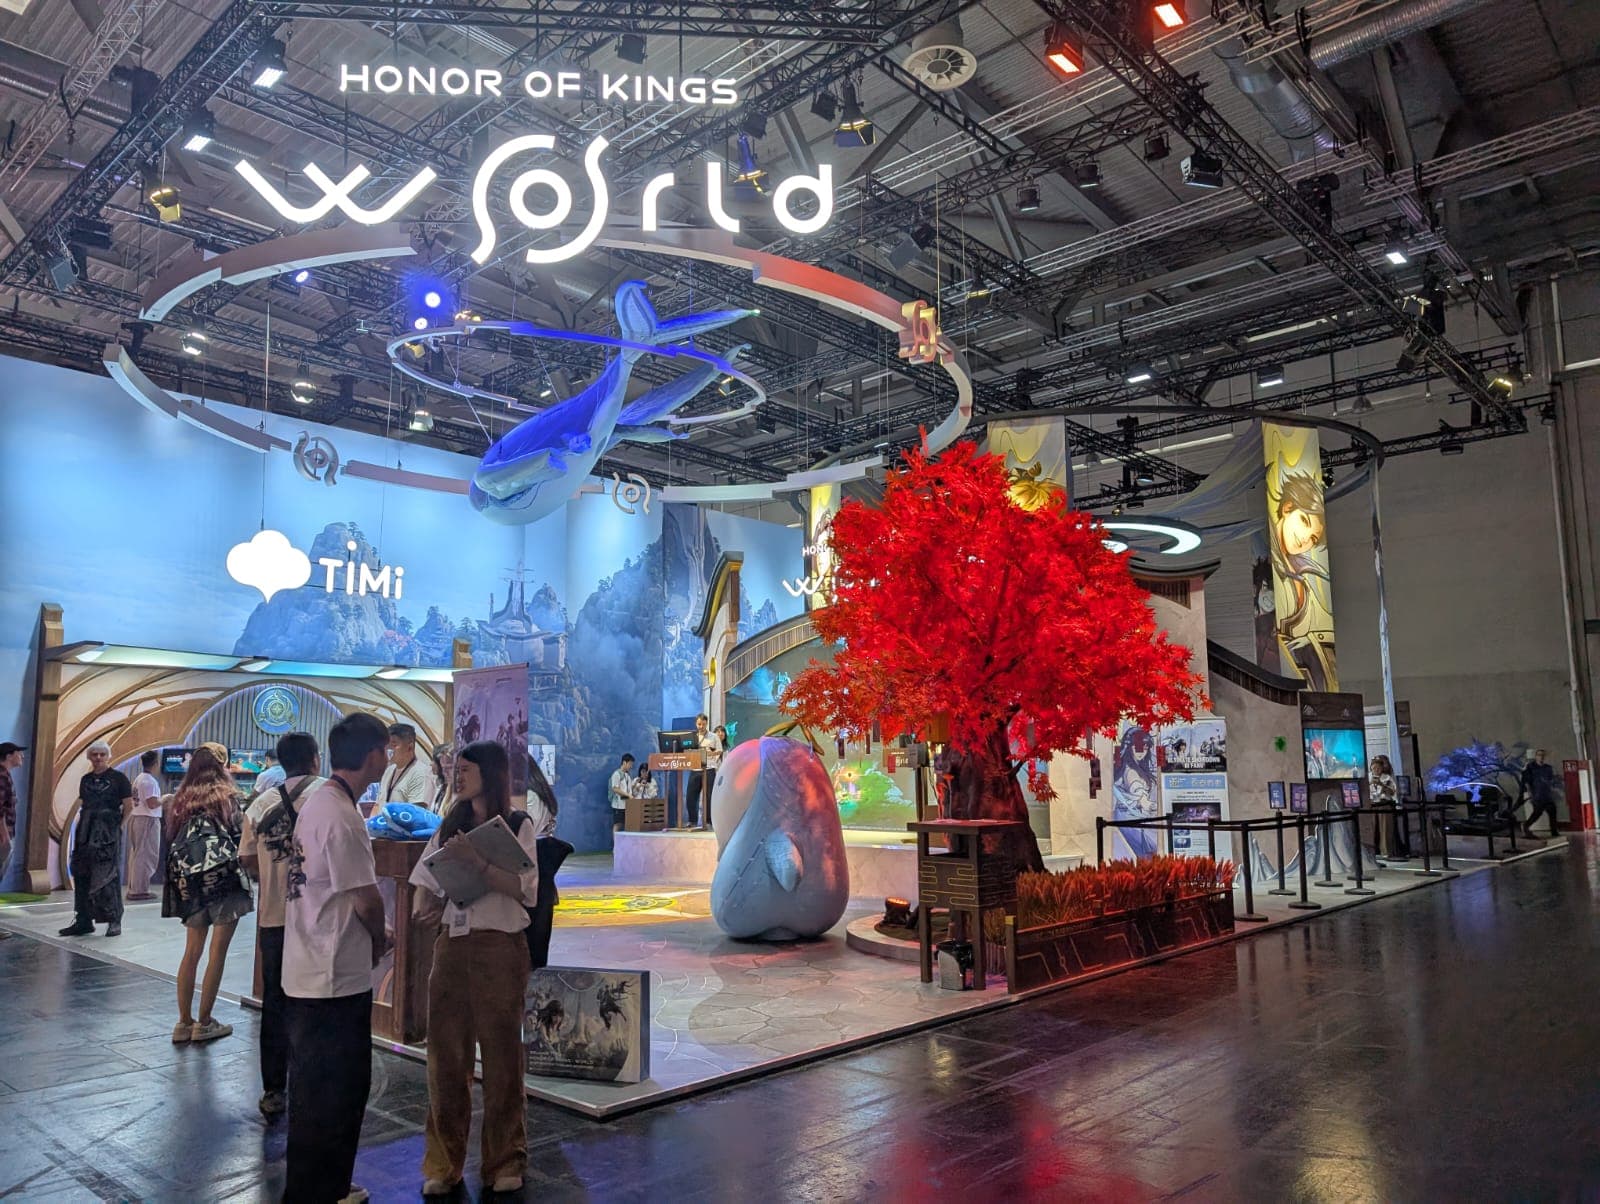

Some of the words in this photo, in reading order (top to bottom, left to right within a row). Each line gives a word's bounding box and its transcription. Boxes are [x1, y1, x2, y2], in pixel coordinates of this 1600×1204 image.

[339, 64, 503, 98] HONOR
[524, 71, 581, 99] OF
[602, 73, 739, 105] KINGS
